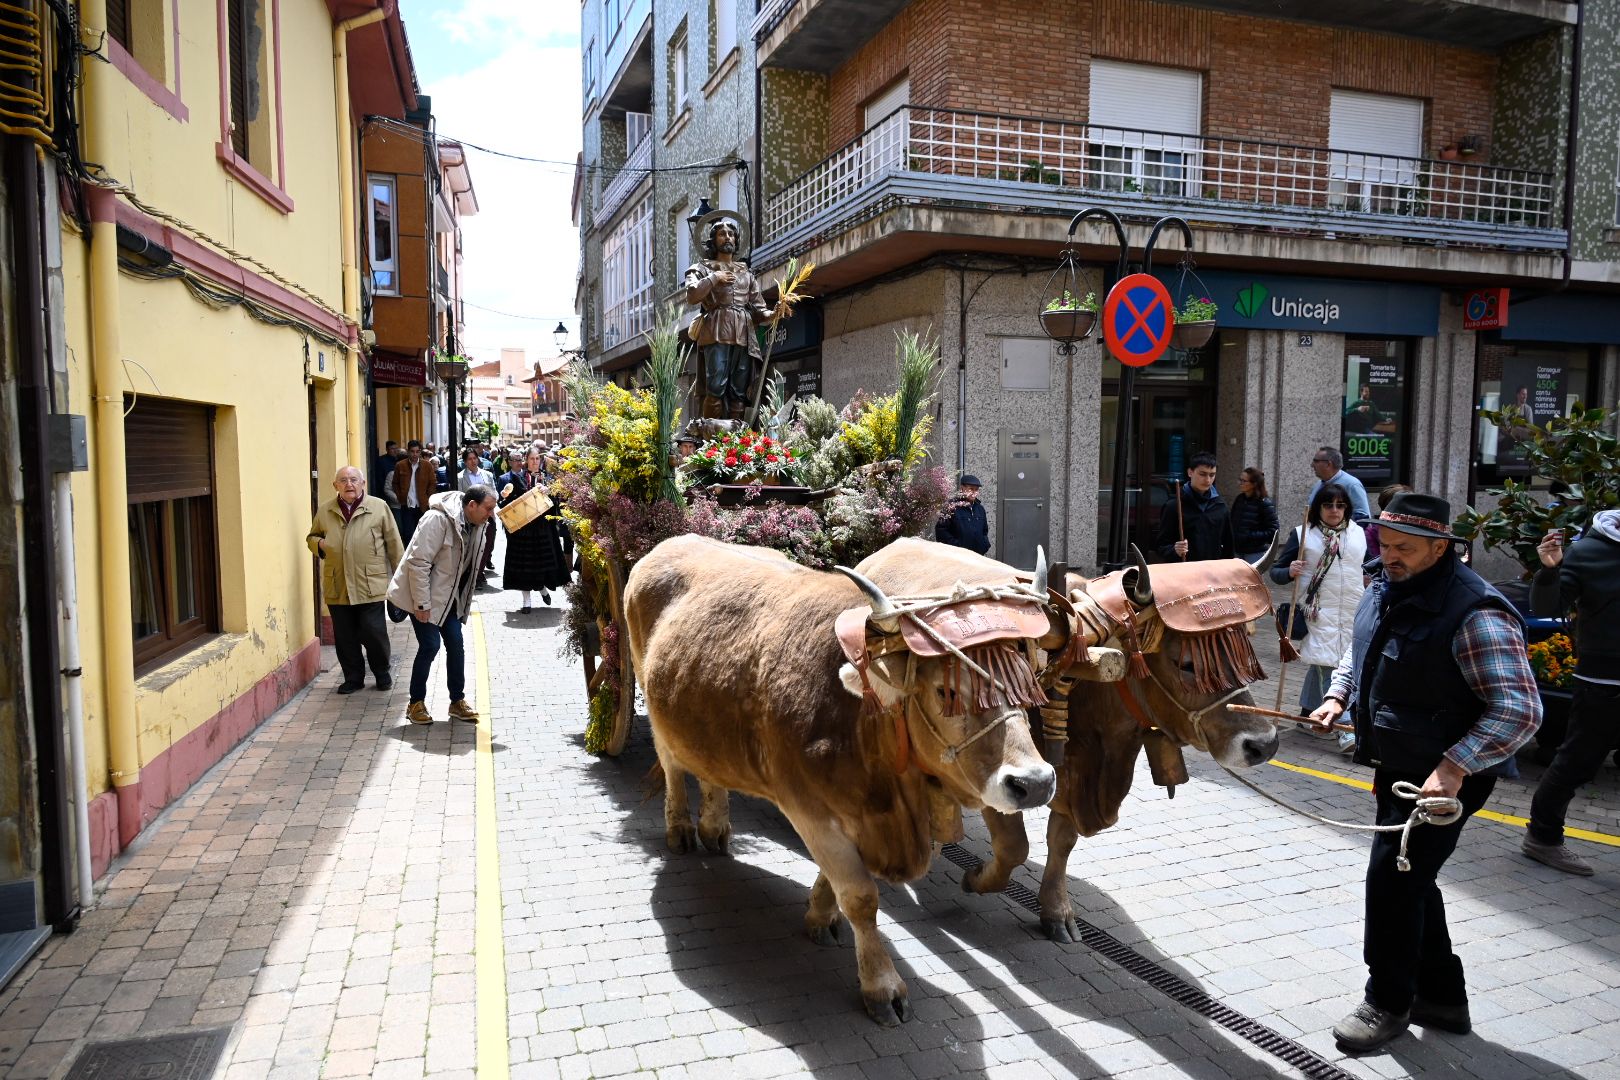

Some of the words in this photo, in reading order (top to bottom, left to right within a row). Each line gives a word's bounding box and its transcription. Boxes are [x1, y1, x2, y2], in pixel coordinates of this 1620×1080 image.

[1271, 296, 1339, 325] Unicaja
[766, 325, 787, 347] Ucaja
[1300, 336, 1312, 345] 23
[1536, 366, 1562, 374] Conseguir
[1536, 380, 1559, 390] 450€
